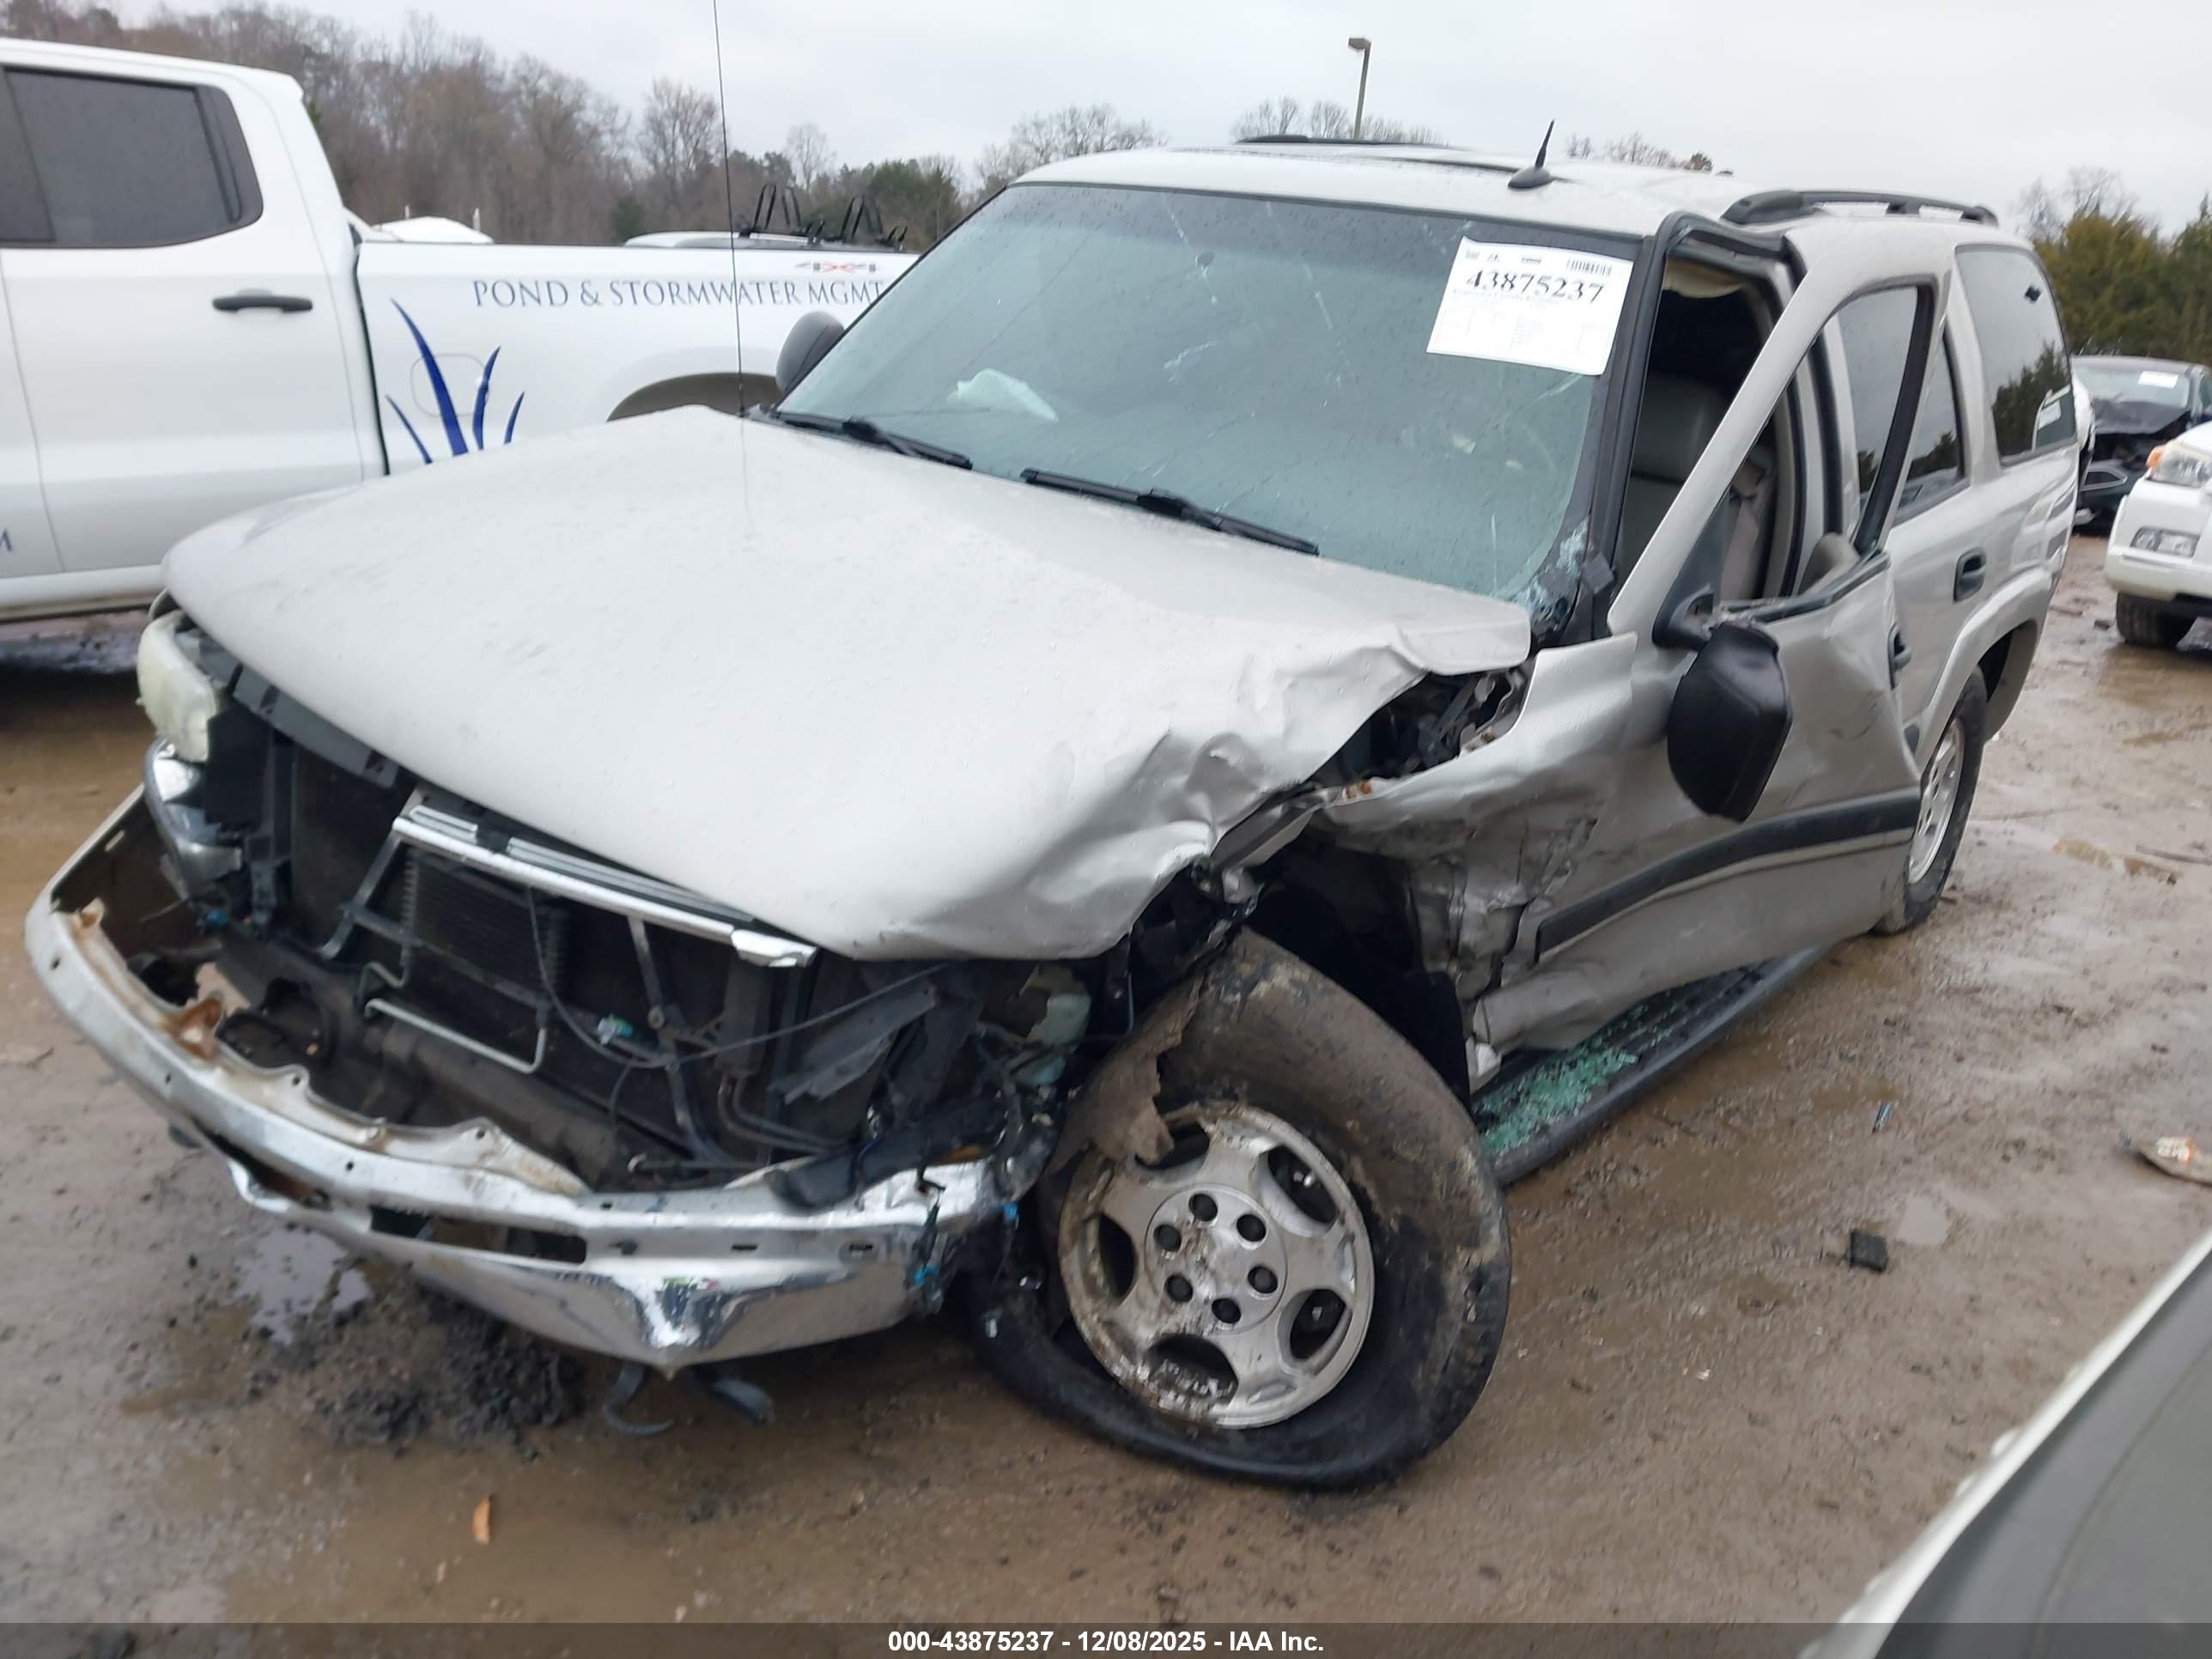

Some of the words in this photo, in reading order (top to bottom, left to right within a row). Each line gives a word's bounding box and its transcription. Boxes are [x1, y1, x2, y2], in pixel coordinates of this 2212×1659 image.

[473, 279, 568, 307] POND
[580, 279, 603, 307] &
[609, 279, 802, 306] STORMWATER
[808, 279, 884, 305] MGMT
[1466, 269, 1605, 304] 43875237
